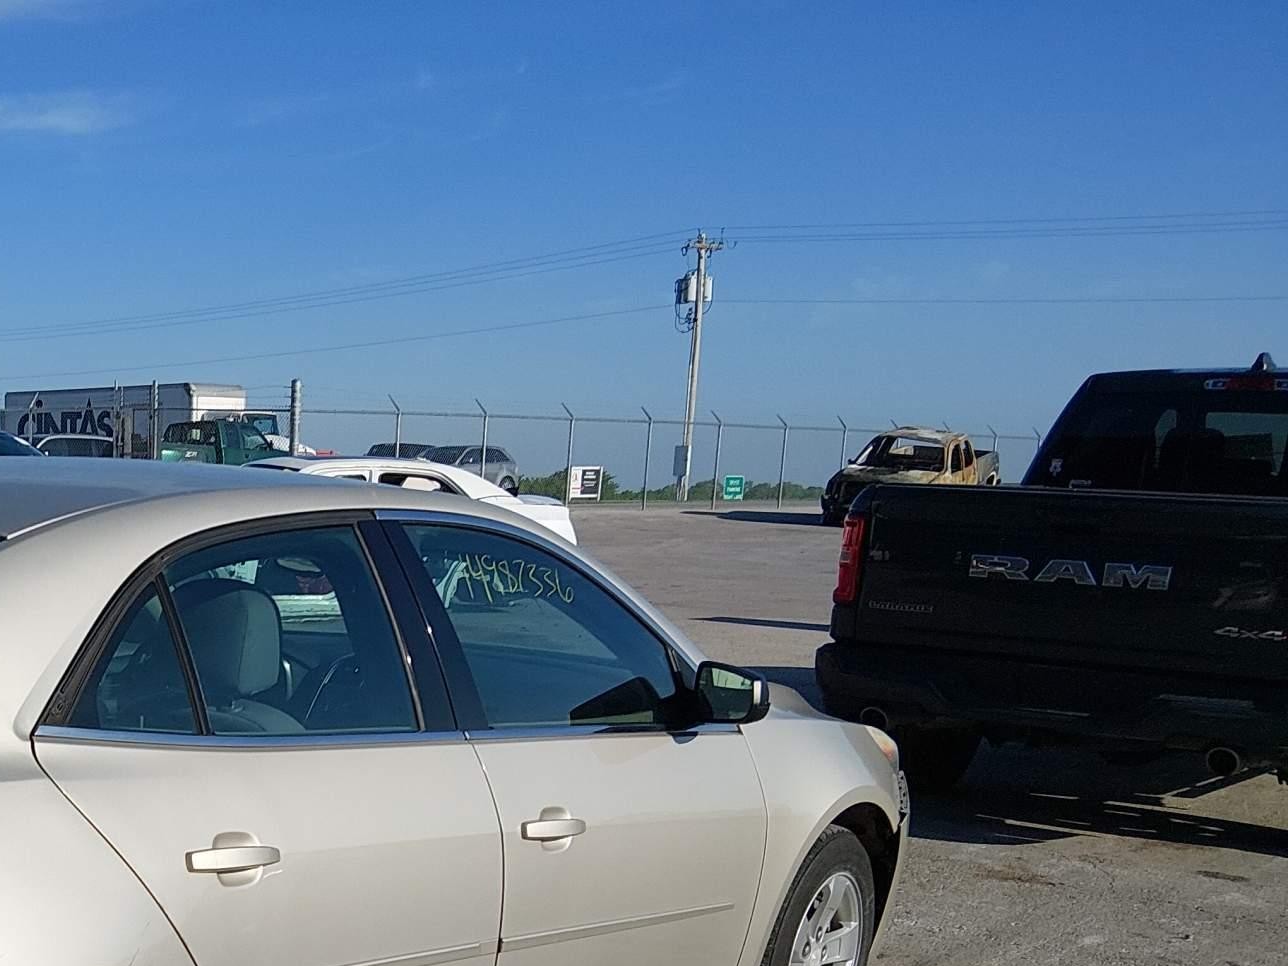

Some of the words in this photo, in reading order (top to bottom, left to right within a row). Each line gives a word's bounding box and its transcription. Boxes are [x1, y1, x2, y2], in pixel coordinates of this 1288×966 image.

[17, 397, 114, 437] CINTAS
[458, 553, 574, 604] 44987336
[968, 554, 1174, 591] RAM
